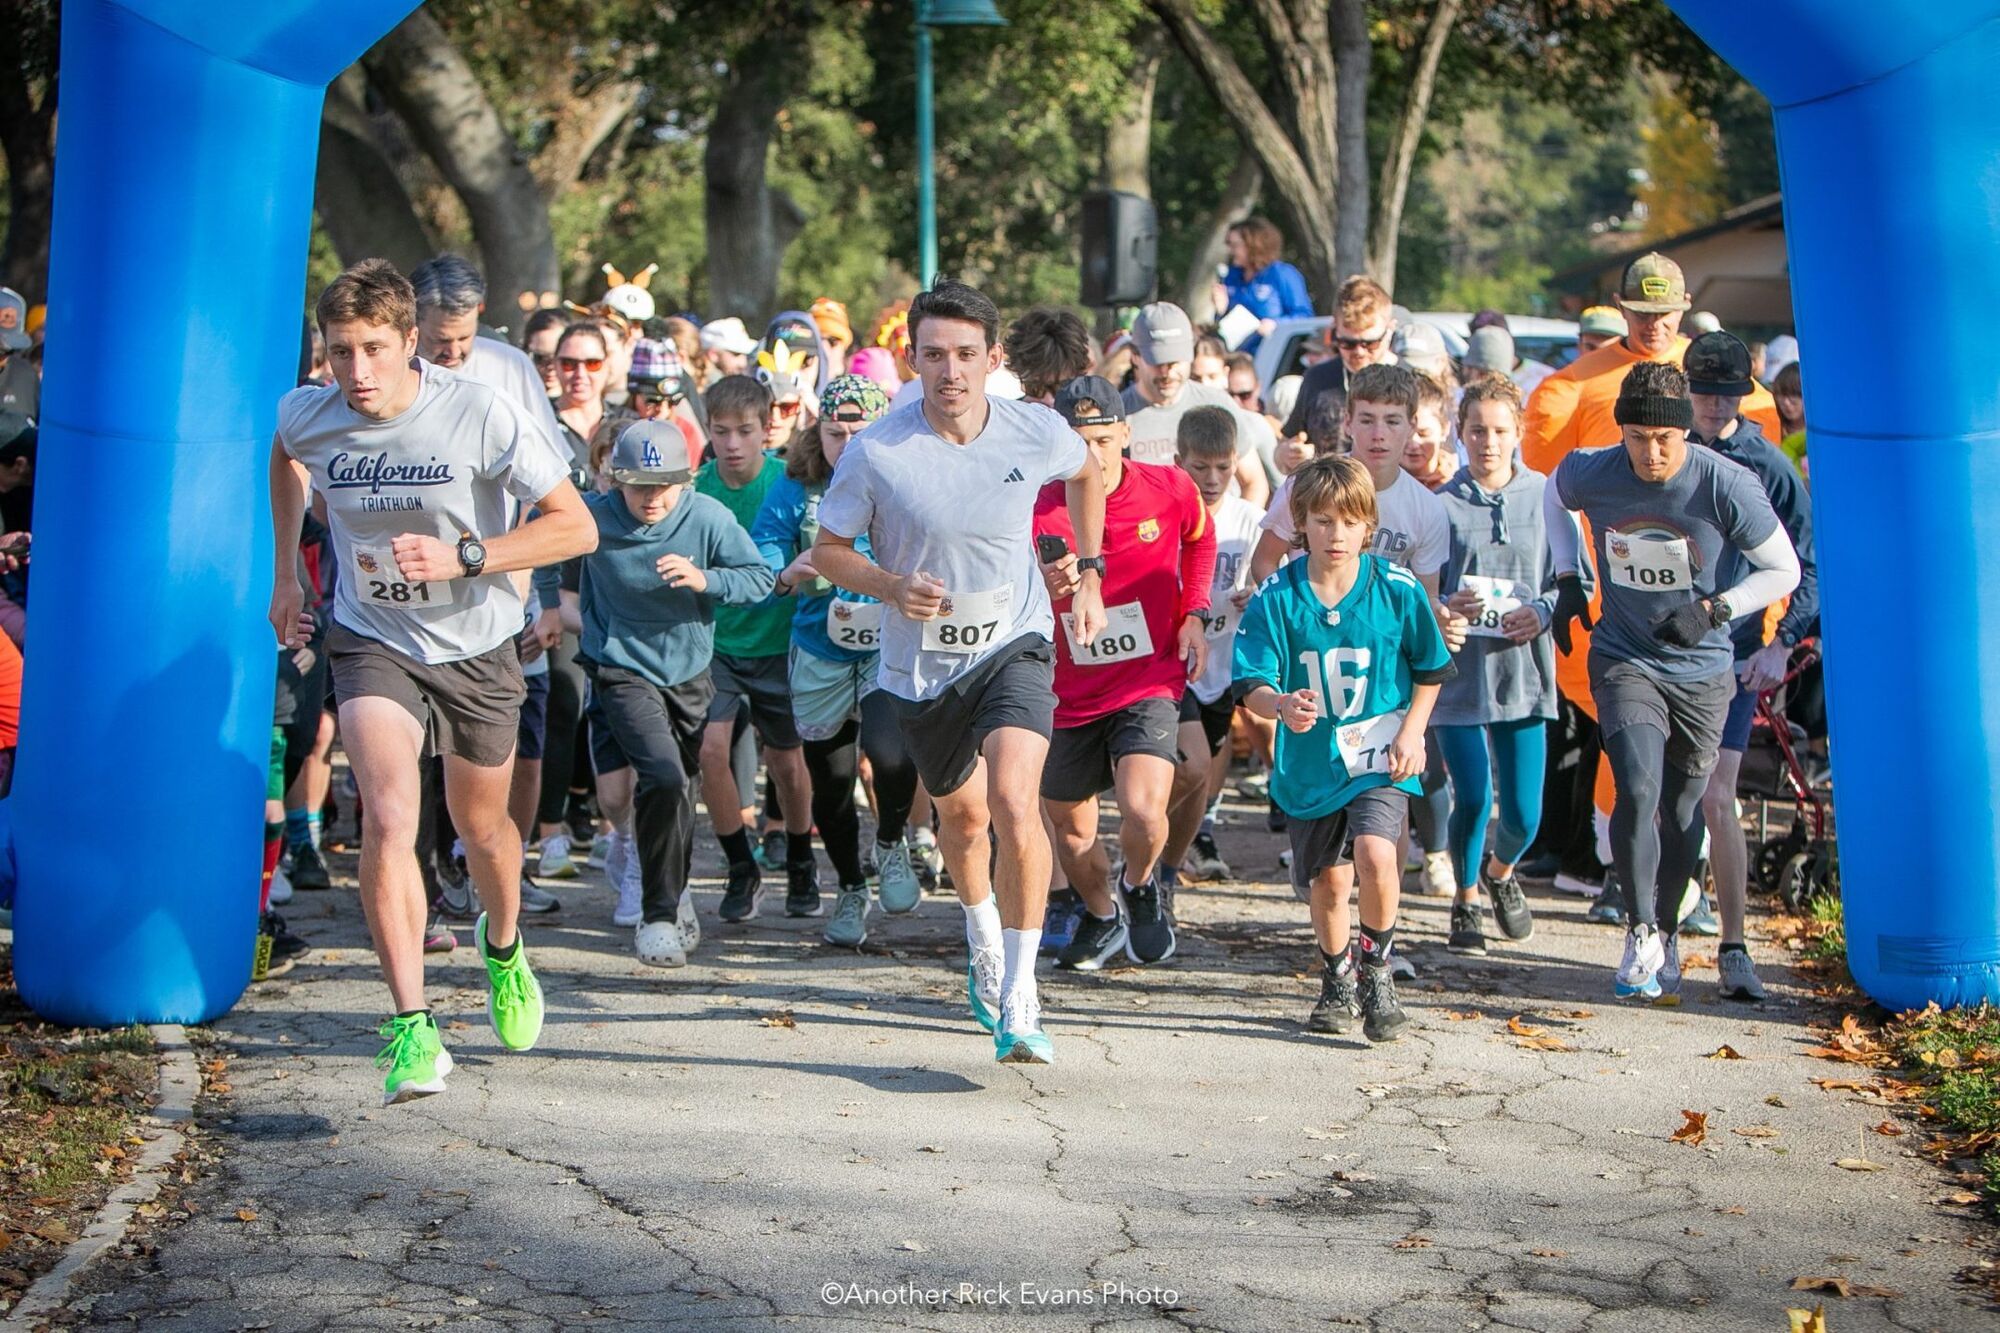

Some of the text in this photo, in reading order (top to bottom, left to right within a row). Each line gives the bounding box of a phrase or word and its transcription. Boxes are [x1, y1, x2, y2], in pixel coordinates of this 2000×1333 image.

[640, 440, 662, 467] LA
[327, 451, 455, 494] California
[360, 496, 424, 513] TRIATHLON
[1624, 564, 1676, 585] 108
[369, 580, 430, 602] 281
[938, 619, 999, 646] 807
[1083, 633, 1136, 658] 180
[1298, 646, 1371, 720] 16
